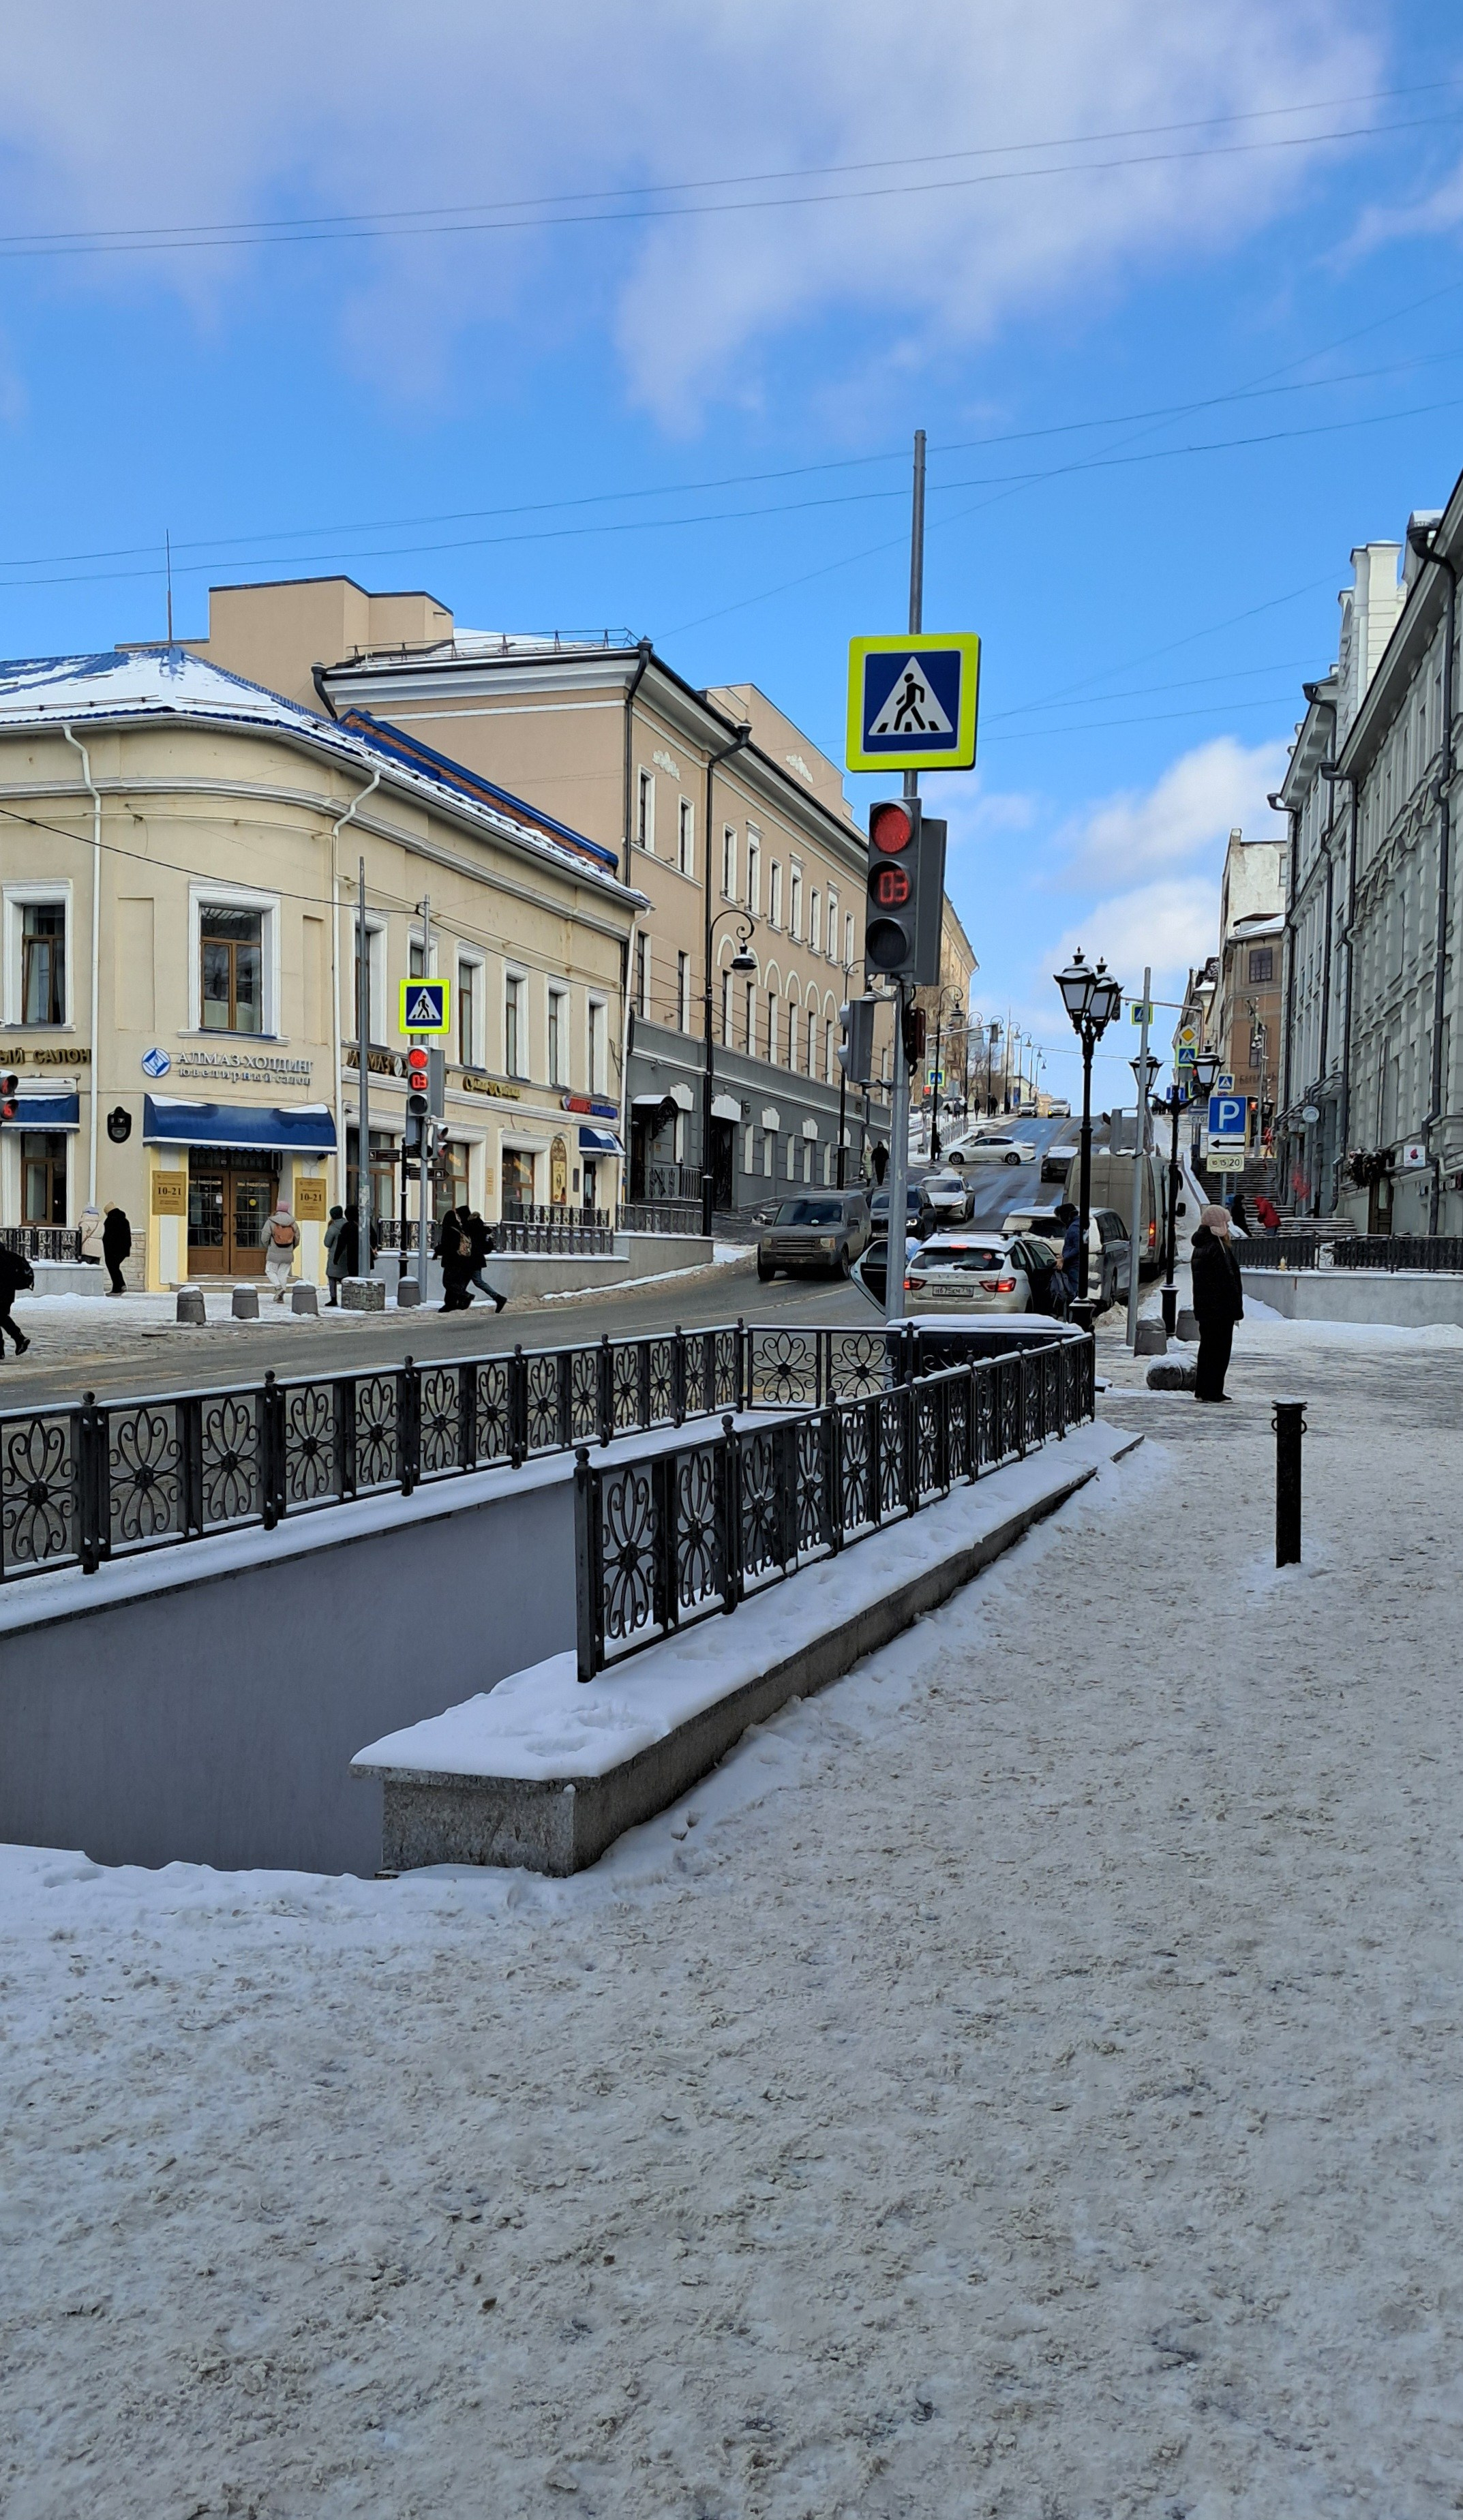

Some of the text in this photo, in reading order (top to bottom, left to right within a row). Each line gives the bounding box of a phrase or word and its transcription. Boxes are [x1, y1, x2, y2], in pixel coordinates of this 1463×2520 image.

[33, 1048, 91, 1064] САЛОН
[177, 1051, 313, 1073] АЛМАЗ-ХОЛДИНГ
[347, 1050, 392, 1075] АМАЗ
[179, 1068, 272, 1082] ювелирный
[1218, 1100, 1240, 1129] P
[1228, 1158, 1240, 1166] 20
[157, 1187, 181, 1196] 10-21
[300, 1193, 322, 1202] 10-21
